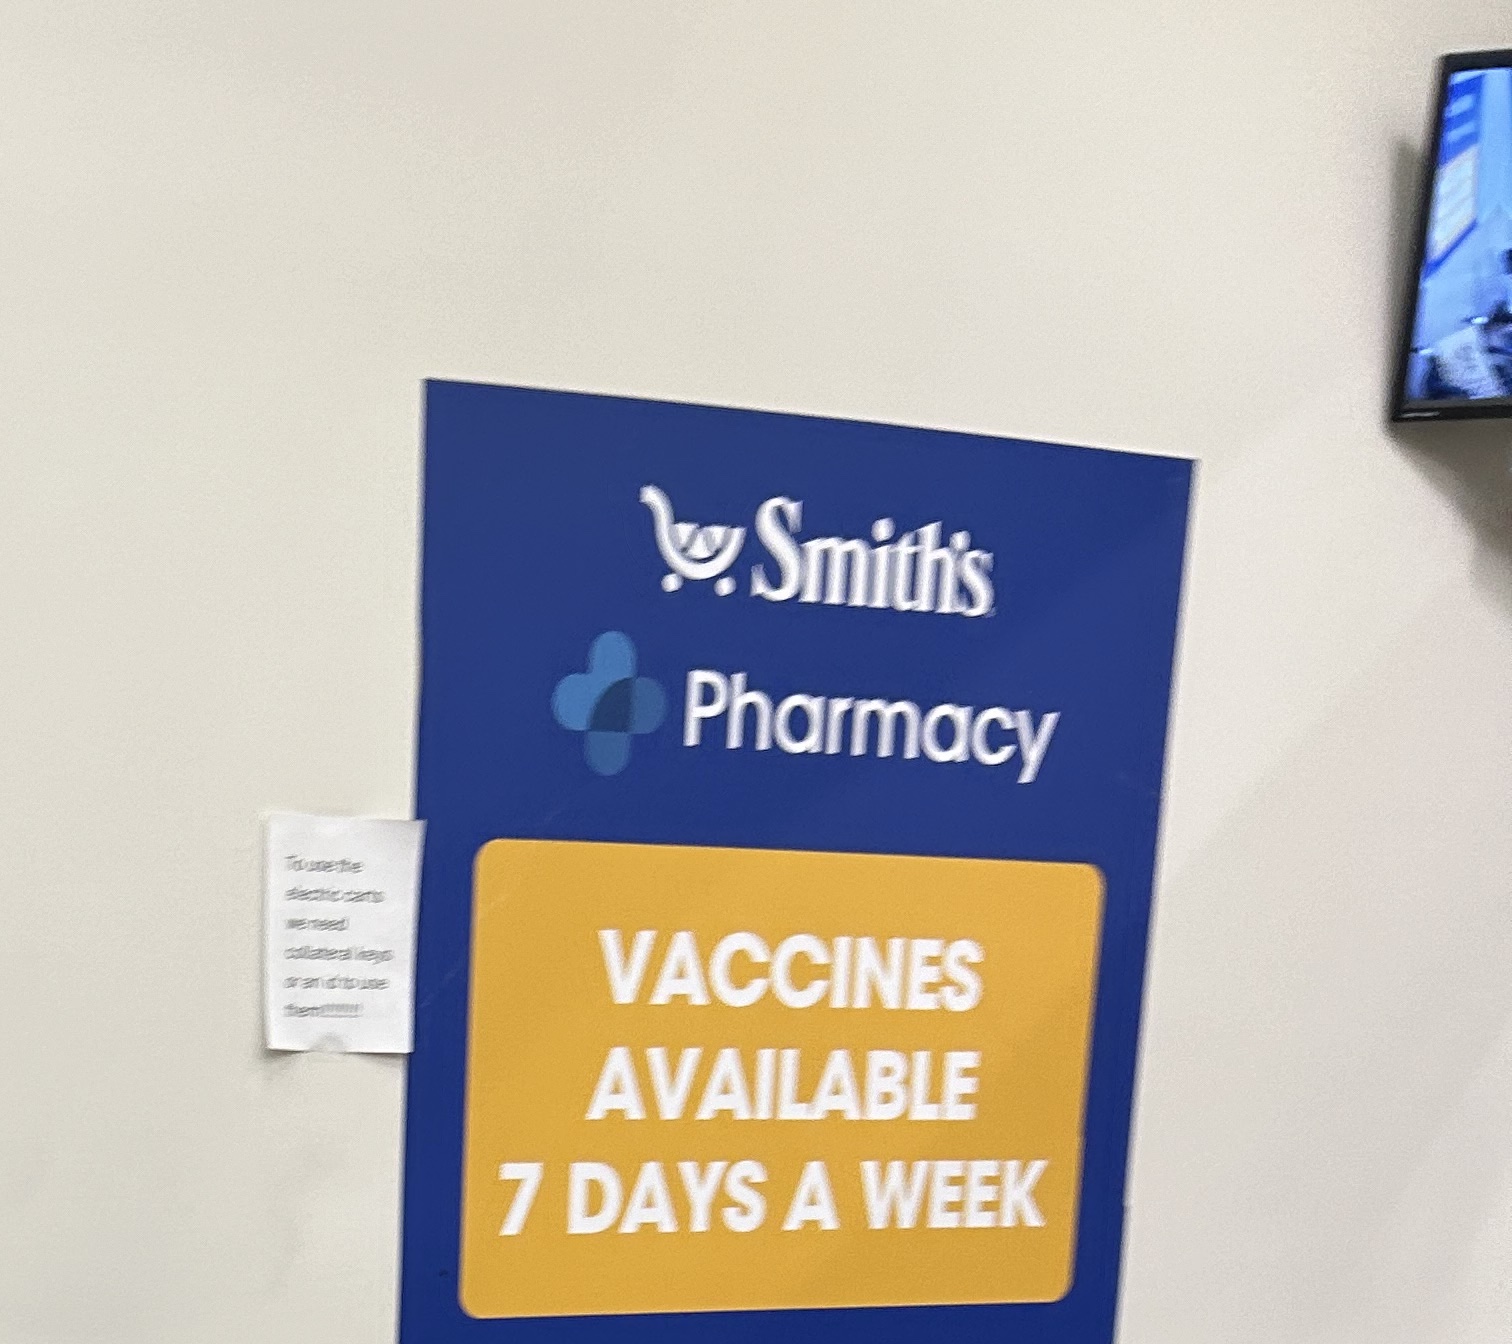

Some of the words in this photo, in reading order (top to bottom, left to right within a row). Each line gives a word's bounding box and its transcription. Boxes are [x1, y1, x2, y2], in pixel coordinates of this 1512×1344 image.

[750, 496, 994, 617] Smith's
[684, 669, 1059, 784] Pharmacy
[598, 928, 985, 1012] VACCINES
[584, 1046, 981, 1121] AVAILABLE
[498, 1161, 544, 1236] 7
[566, 1159, 768, 1236] DAYS
[781, 1160, 841, 1232] A
[859, 1159, 1050, 1230] WEEK
